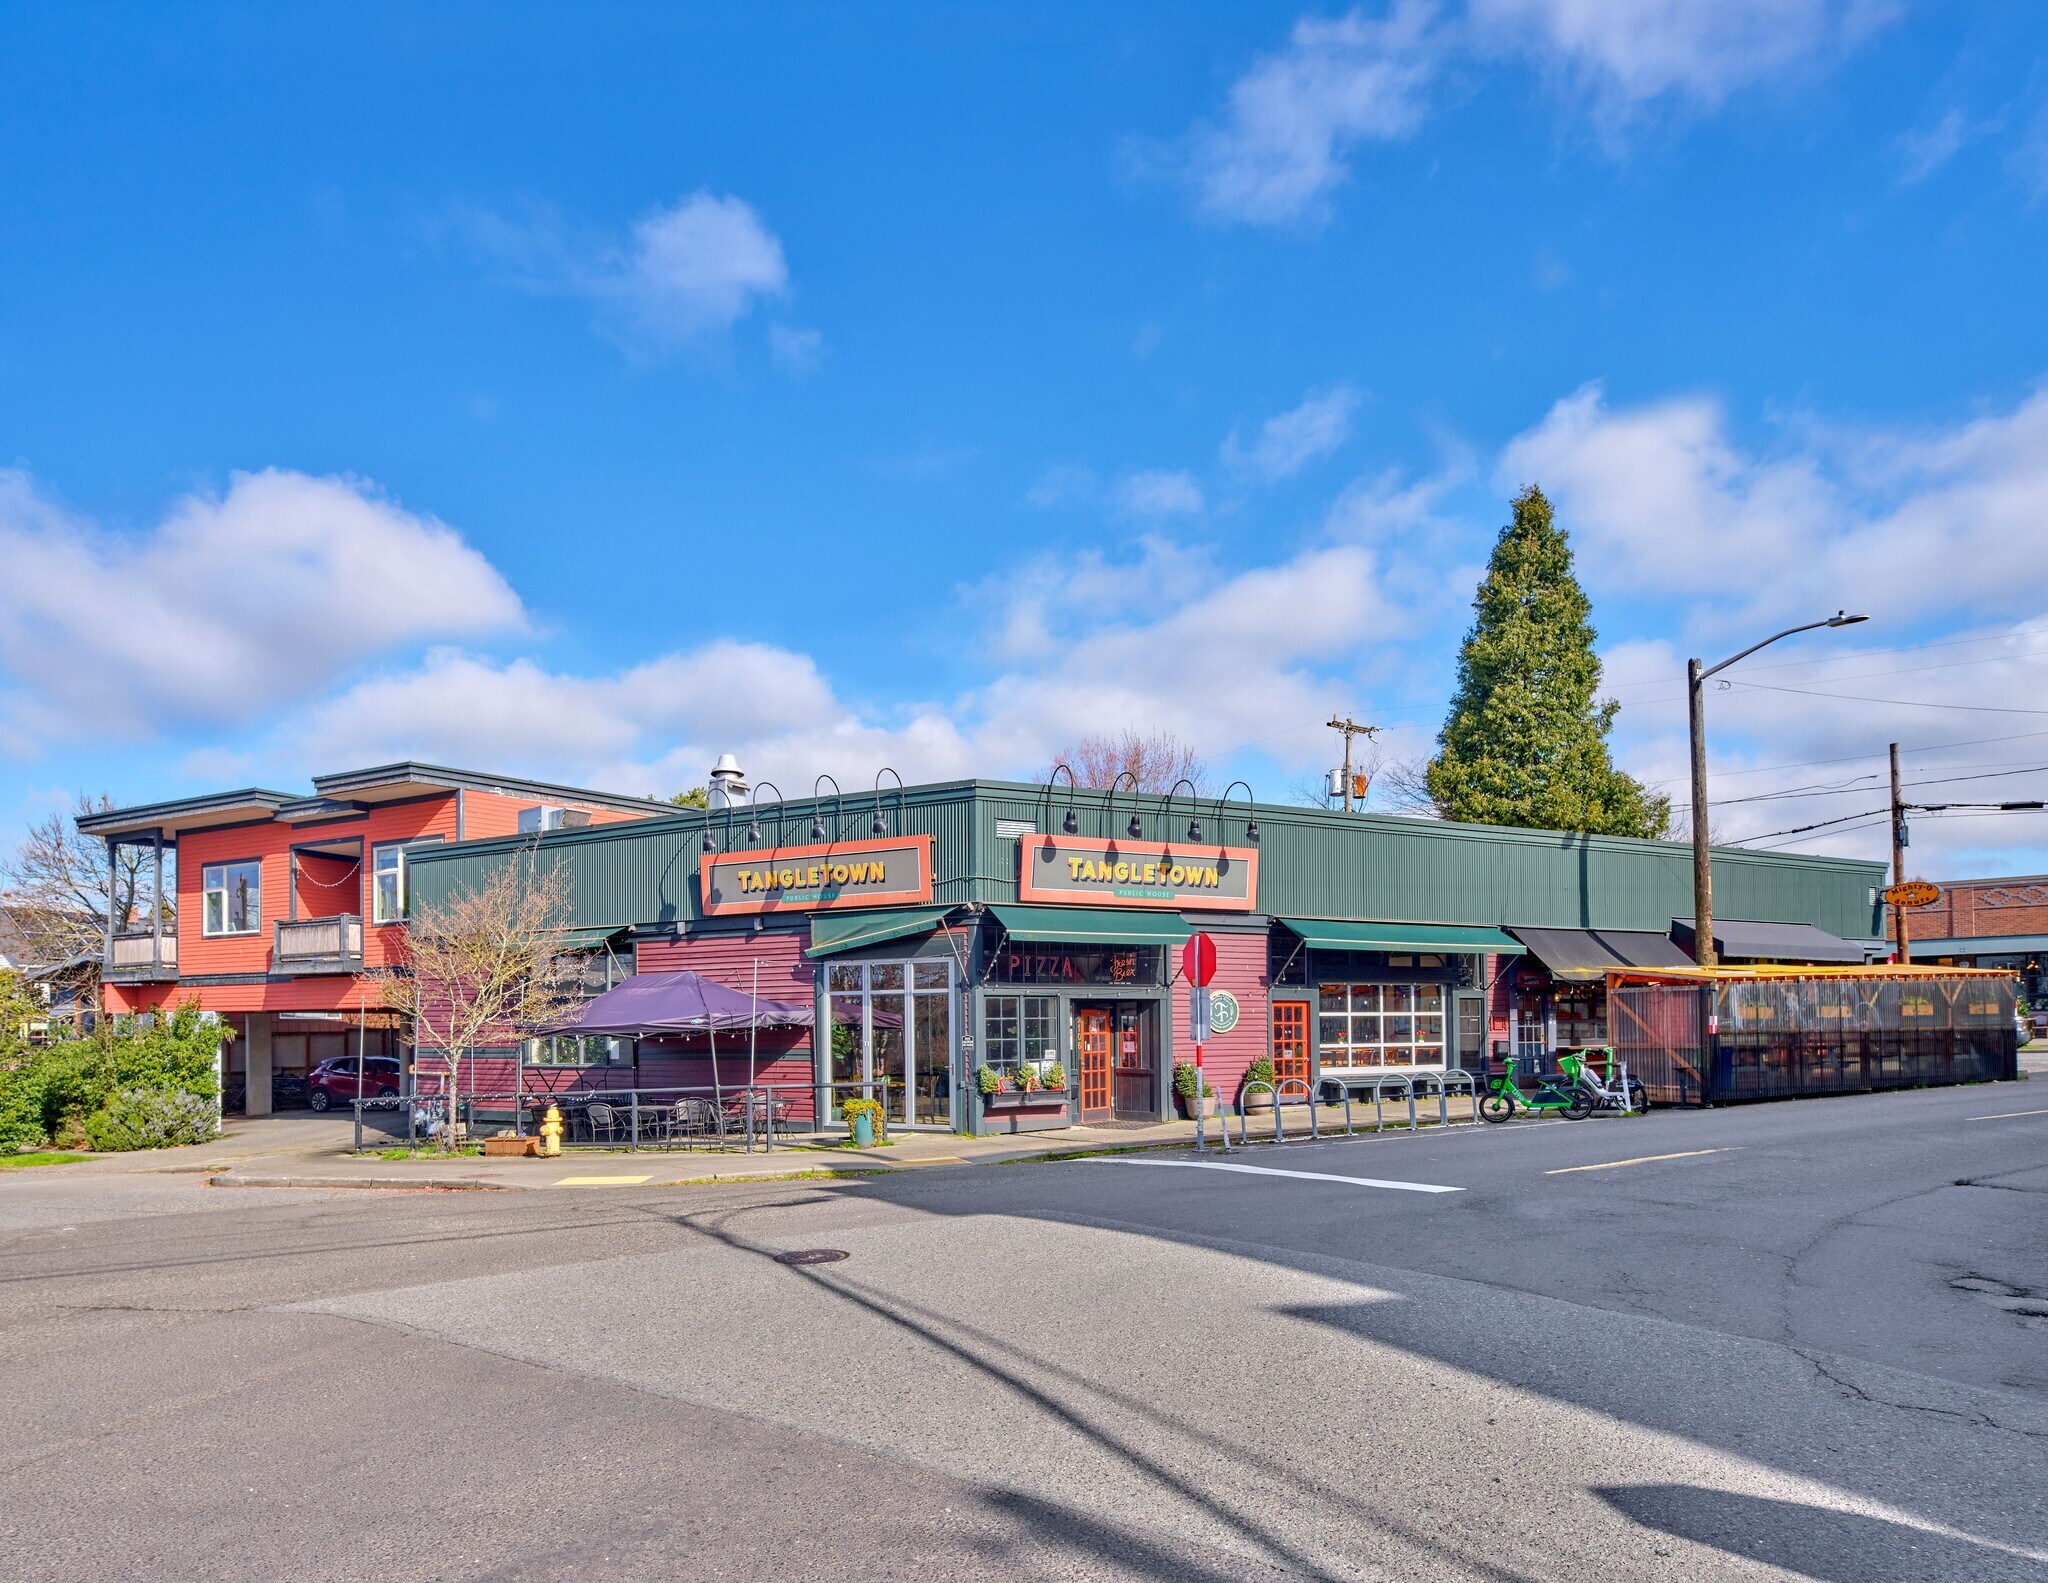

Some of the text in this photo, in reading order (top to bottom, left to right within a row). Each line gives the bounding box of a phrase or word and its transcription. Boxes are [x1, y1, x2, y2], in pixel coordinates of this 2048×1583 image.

[738, 861, 885, 893] TANGLETOWN
[1068, 857, 1219, 888] TANGLETOWN
[1119, 889, 1144, 897] PUBLIC
[1891, 884, 1933, 895] Mighty-O
[1894, 896, 1930, 905] donuts
[1009, 955, 1073, 977] PIZZA
